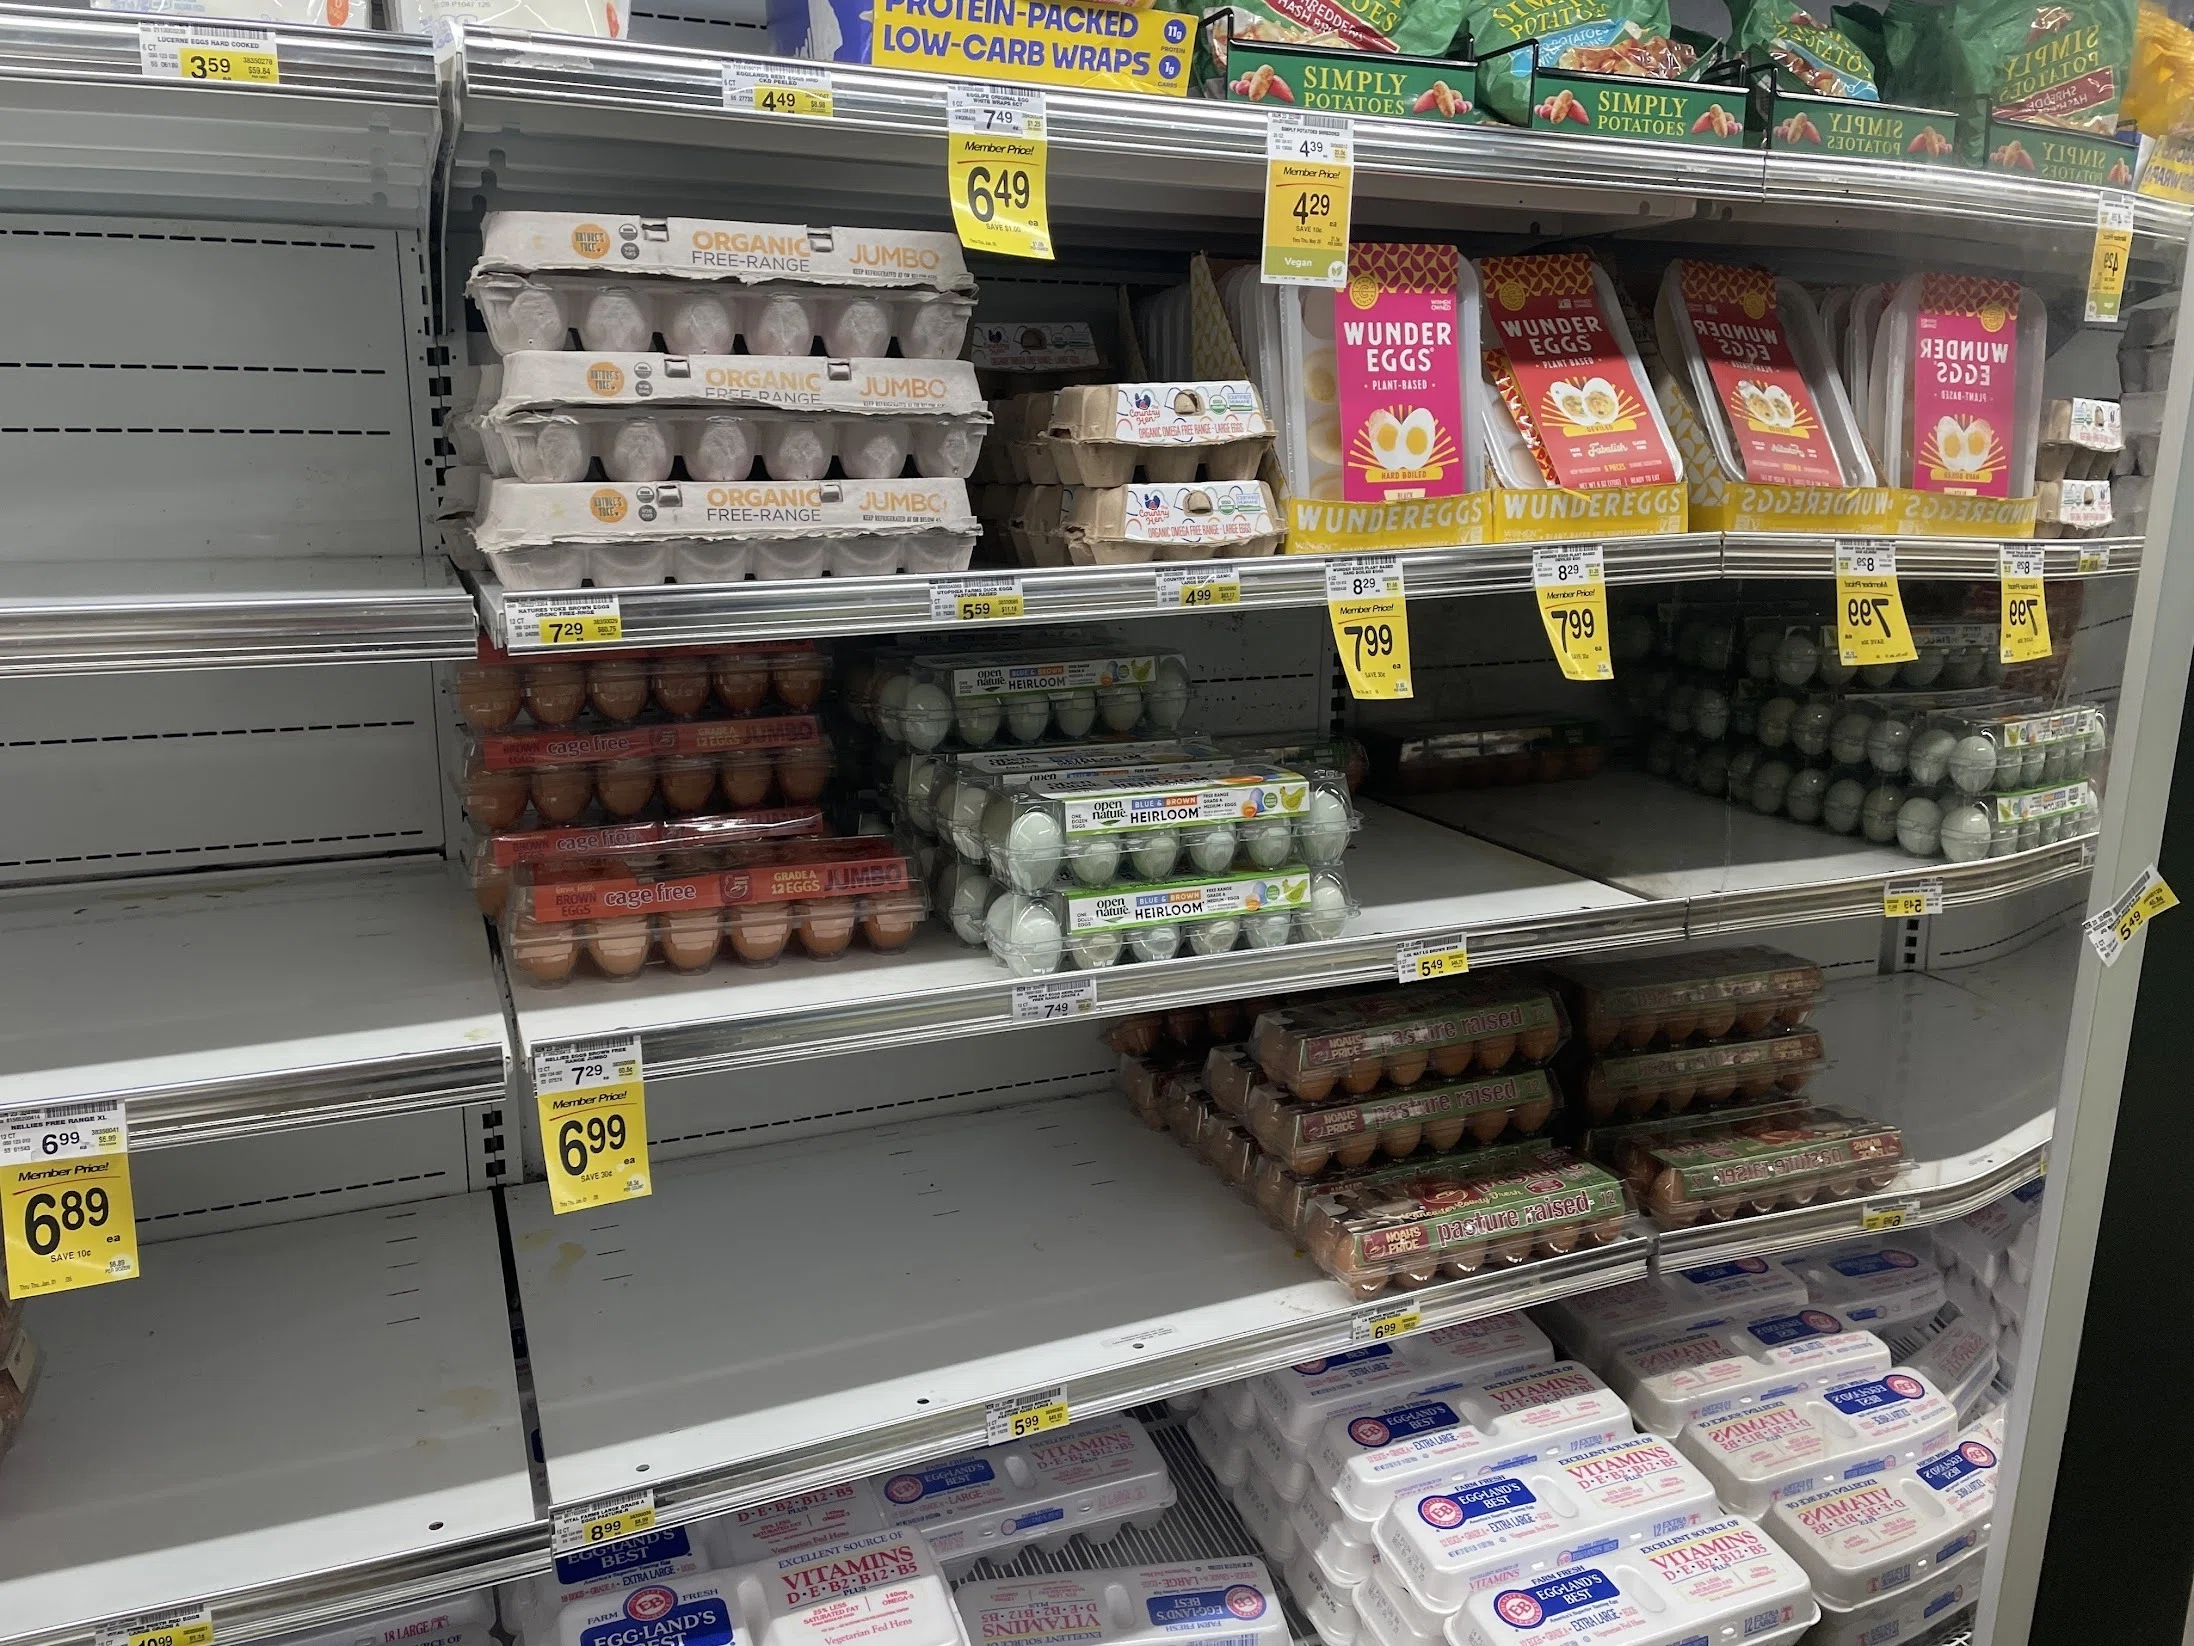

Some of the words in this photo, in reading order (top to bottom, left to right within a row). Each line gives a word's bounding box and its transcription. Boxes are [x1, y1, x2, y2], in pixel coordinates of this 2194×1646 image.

[883, 24, 1045, 66] LOW-CARB
[1052, 42, 1151, 77] WRAPS
[1303, 63, 1407, 96] SIMPLY
[1303, 91, 1405, 116] POTATOES
[1598, 90, 1688, 118] SIMPLY
[1597, 115, 1685, 137] POTATOES
[965, 141, 1006, 153] Member
[1007, 144, 1035, 155] Price!
[1283, 166, 1318, 178] Member
[1318, 169, 1341, 179] Price!
[986, 223, 1004, 232] SAVE
[1296, 225, 1312, 233] SAVE
[692, 230, 811, 257] ORGANIC
[692, 249, 810, 273] FREE-RANGE
[848, 243, 940, 270] JUMBO
[1284, 257, 1313, 267] Vegan
[1343, 321, 1452, 346] WUNDER
[1500, 315, 1604, 338] WUNDER
[1528, 333, 1593, 356] EGGS
[1366, 348, 1433, 373] EGGS
[704, 367, 822, 392] ORGANIC
[859, 376, 948, 399] JUMBO
[1372, 379, 1428, 391] PLANT-BASED
[1129, 409, 1161, 422] Country
[1138, 426, 1162, 438] ORGANIC
[1162, 425, 1181, 437] OMEGA
[1181, 424, 1194, 435] FREE
[1194, 423, 1212, 434] RANGE
[1213, 422, 1230, 434] LARGE
[1230, 422, 1244, 432] EGGS
[1586, 424, 1614, 433] DEVILED
[1381, 471, 1400, 480] HARD
[1402, 470, 1427, 479] BOILED
[706, 487, 823, 507] ORGANIC
[1503, 487, 1683, 520] WUNDEREGGS
[706, 508, 822, 522] FREE-RANGE
[1138, 509, 1170, 521] Country
[1296, 496, 1483, 534] WUNDEREGGS
[1148, 526, 1171, 538] ORGANIC
[1171, 525, 1190, 538] OMEGA
[1190, 525, 1202, 535] FREE
[1203, 524, 1220, 534] RANGE
[1222, 523, 1239, 534] LARGE
[1239, 523, 1252, 534] EGGS
[1546, 590, 1575, 600] Member
[1340, 605, 1372, 615] Member
[1372, 604, 1394, 613] Price!
[1008, 676, 1065, 690] HEIRLOOM
[1094, 800, 1122, 811] open
[1134, 800, 1154, 809] BLUE
[1166, 797, 1196, 806] BROWN
[1130, 808, 1199, 824] HEIRLOOM
[773, 871, 807, 882] GRADE
[602, 889, 655, 910] cage
[654, 881, 697, 903] free
[770, 883, 785, 895] 12
[785, 879, 821, 894] EGGS
[1096, 897, 1125, 909] open
[1139, 897, 1159, 906] BLUE
[1170, 892, 1200, 902] BROWN
[560, 904, 592, 917] EGGS
[1135, 903, 1203, 920] HEIRLOOM
[1377, 1020, 1457, 1054] pasture
[1460, 1006, 1524, 1036] raised
[552, 1095, 597, 1110] Member
[598, 1090, 628, 1103] Price!
[1371, 1093, 1451, 1129] pasture
[1455, 1079, 1518, 1109] raised
[10, 1120, 44, 1130] NELLIES
[45, 1118, 67, 1127] FREE
[68, 1116, 95, 1125] RANGE
[623, 1157, 636, 1165] ea
[17, 1167, 72, 1182] Member
[74, 1161, 110, 1176] Price!
[580, 1172, 600, 1183] SAVE
[1598, 1189, 1617, 1207] 12
[1436, 1210, 1520, 1249] pasture
[1524, 1190, 1591, 1224] raised
[106, 1233, 121, 1243] ea
[50, 1251, 75, 1263] SAVE
[1489, 1372, 1589, 1405] VITAMINS
[1408, 1416, 1435, 1431] BEST
[1031, 1429, 1132, 1461] VITAMINS
[1412, 1436, 1438, 1451] EXTRA
[1437, 1432, 1458, 1446] LARGE
[1557, 1448, 1606, 1466] EXCELLENT
[1606, 1440, 1642, 1454] SOURCE
[1566, 1445, 1670, 1479] VITAMINS
[945, 1474, 971, 1487] BEST
[1453, 1480, 1479, 1492] FARM
[1478, 1474, 1506, 1486] FRESH
[1624, 1473, 1643, 1483] PLUS
[1483, 1495, 1511, 1509] BEST
[1487, 1518, 1513, 1533] EXTRA
[1510, 1513, 1536, 1528] LARGE
[1639, 1534, 1685, 1554] EXCELLENT
[1684, 1523, 1725, 1544] SOURCE
[600, 1546, 650, 1569] BEST
[778, 1546, 841, 1569] EXCELLENT
[843, 1534, 888, 1551] SOURCE
[890, 1530, 904, 1540] OF
[1649, 1530, 1761, 1570] VITAMINS
[622, 1574, 650, 1586] EXTRA
[649, 1566, 676, 1580] LARGE
[781, 1545, 914, 1590] VITAMINS
[1530, 1572, 1554, 1586] FARM
[1554, 1565, 1586, 1579] FRESH
[1712, 1563, 1732, 1572] PLUS
[843, 1586, 867, 1596] PLUS
[1564, 1588, 1594, 1606] BEST
[587, 1611, 618, 1625] FARM
[682, 1588, 719, 1601] FRESH
[829, 1602, 848, 1610] LESS
[803, 1609, 845, 1625] SATURATED
[1570, 1615, 1598, 1632] EXTRA
[1597, 1608, 1619, 1626] LARGE
[396, 1621, 429, 1640] LARGE
[824, 1626, 871, 1646] Vegetarian
[871, 1622, 888, 1634] Fed
[889, 1617, 913, 1631] Hens
